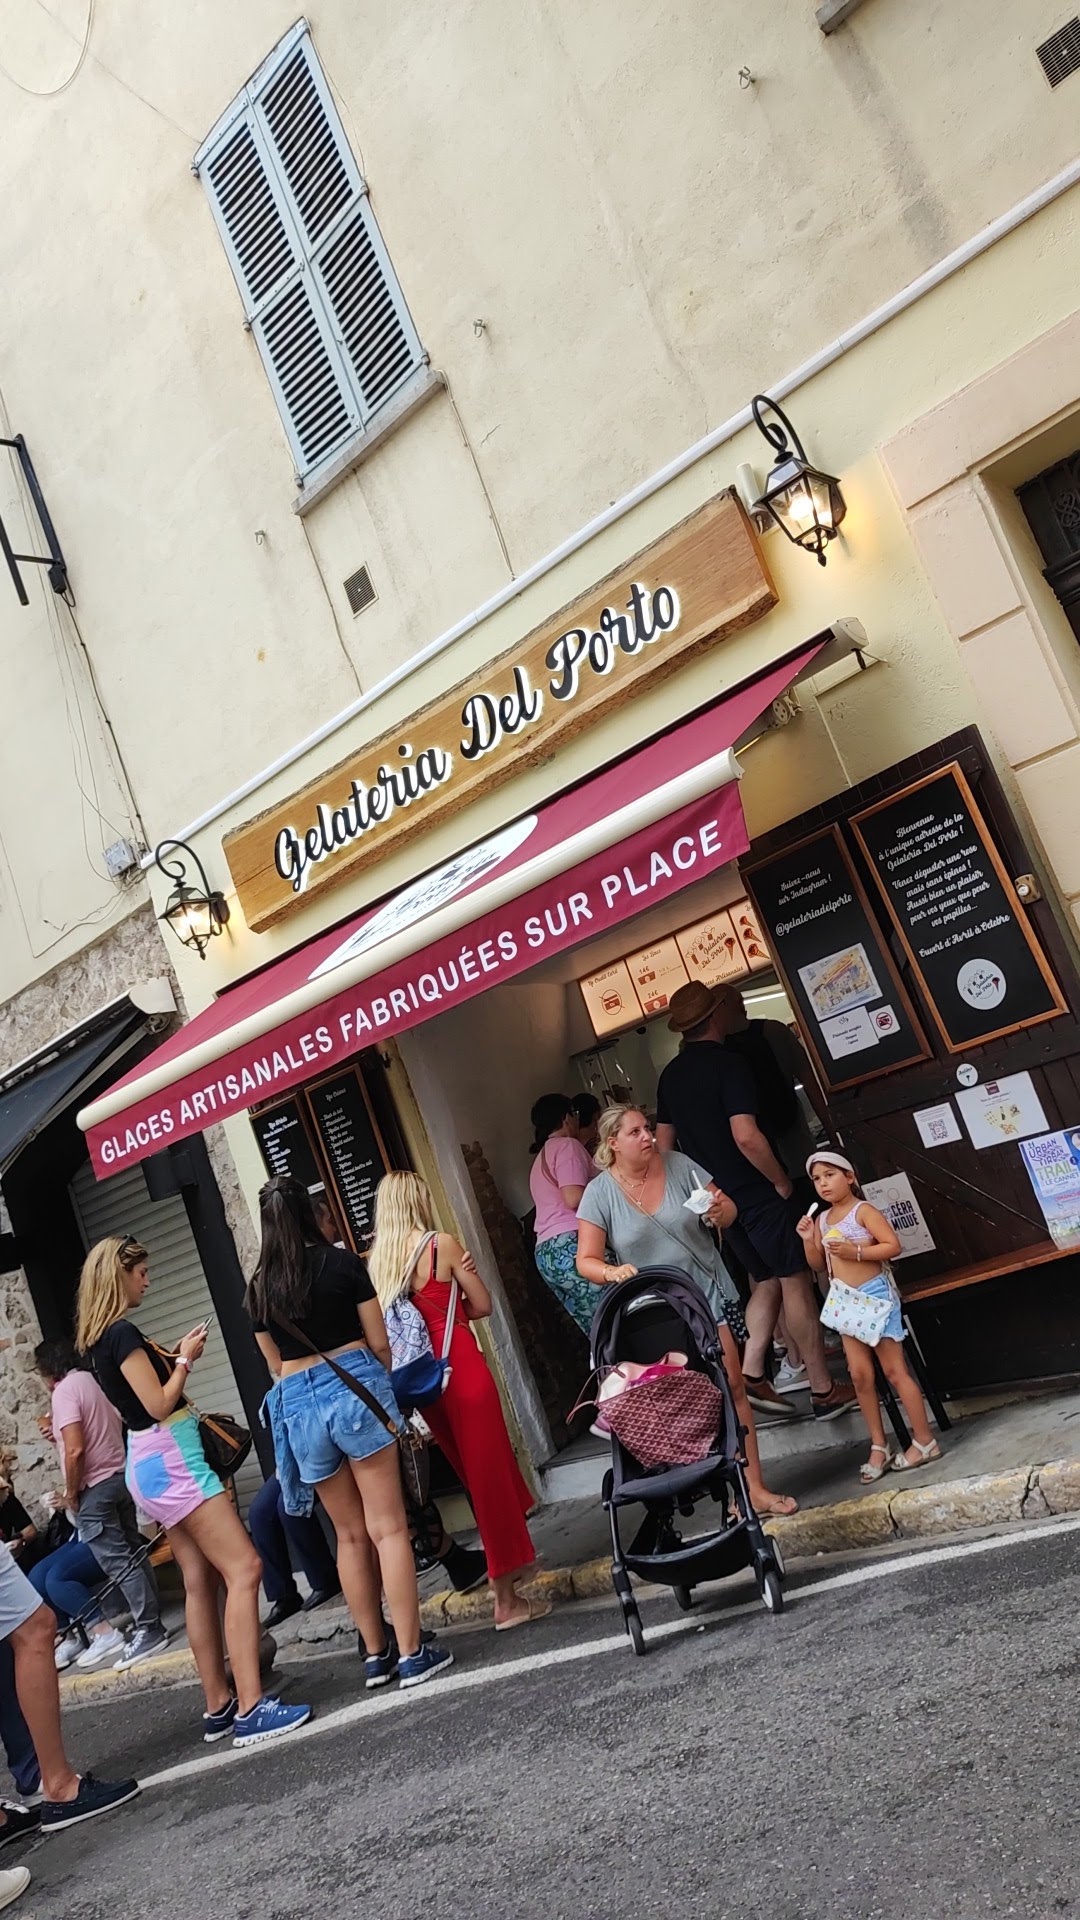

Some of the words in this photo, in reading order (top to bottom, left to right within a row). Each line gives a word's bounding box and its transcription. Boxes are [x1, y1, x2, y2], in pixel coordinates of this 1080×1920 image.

[275, 743, 451, 893] Gelateria
[460, 667, 543, 759] Del
[545, 584, 680, 700] Porto
[895, 814, 934, 837] Bienvenue
[914, 823, 943, 842] adresse
[943, 817, 953, 827] de
[953, 813, 963, 822] la
[887, 848, 922, 871] Gelateria
[923, 838, 937, 851] Del
[937, 829, 958, 844] Porto
[891, 875, 913, 889] Venez
[914, 859, 945, 880] déguster
[945, 853, 961, 864] une
[960, 845, 977, 856] rose
[790, 878, 827, 899] Instagram
[906, 883, 924, 897] mais
[925, 875, 943, 888] sans
[906, 894, 928, 911] Aussi
[928, 888, 945, 900] bien
[945, 883, 957, 892] un
[955, 869, 983, 890] plaisir
[909, 910, 926, 925] pour
[926, 905, 938, 915] vos
[938, 897, 957, 912] yeux
[957, 890, 971, 903] que
[971, 880, 990, 897] pour
[931, 917, 942, 927] vos
[918, 940, 944, 957] Ouvert
[974, 925, 981, 934] à
[980, 914, 1010, 932] Octobre
[701, 956, 710, 968] Del
[100, 1109, 174, 1164] GLACES
[180, 1026, 333, 1125] ARTISANALES
[338, 934, 518, 1042] FABRIQUÉES
[524, 892, 594, 948] SUR
[601, 819, 722, 909] PLACE
[1029, 1138, 1057, 1158] URBAN
[1053, 1171, 1079, 1183] CANNET
[891, 1200, 914, 1217] CÉRA
[892, 1212, 919, 1231] MIQUE
